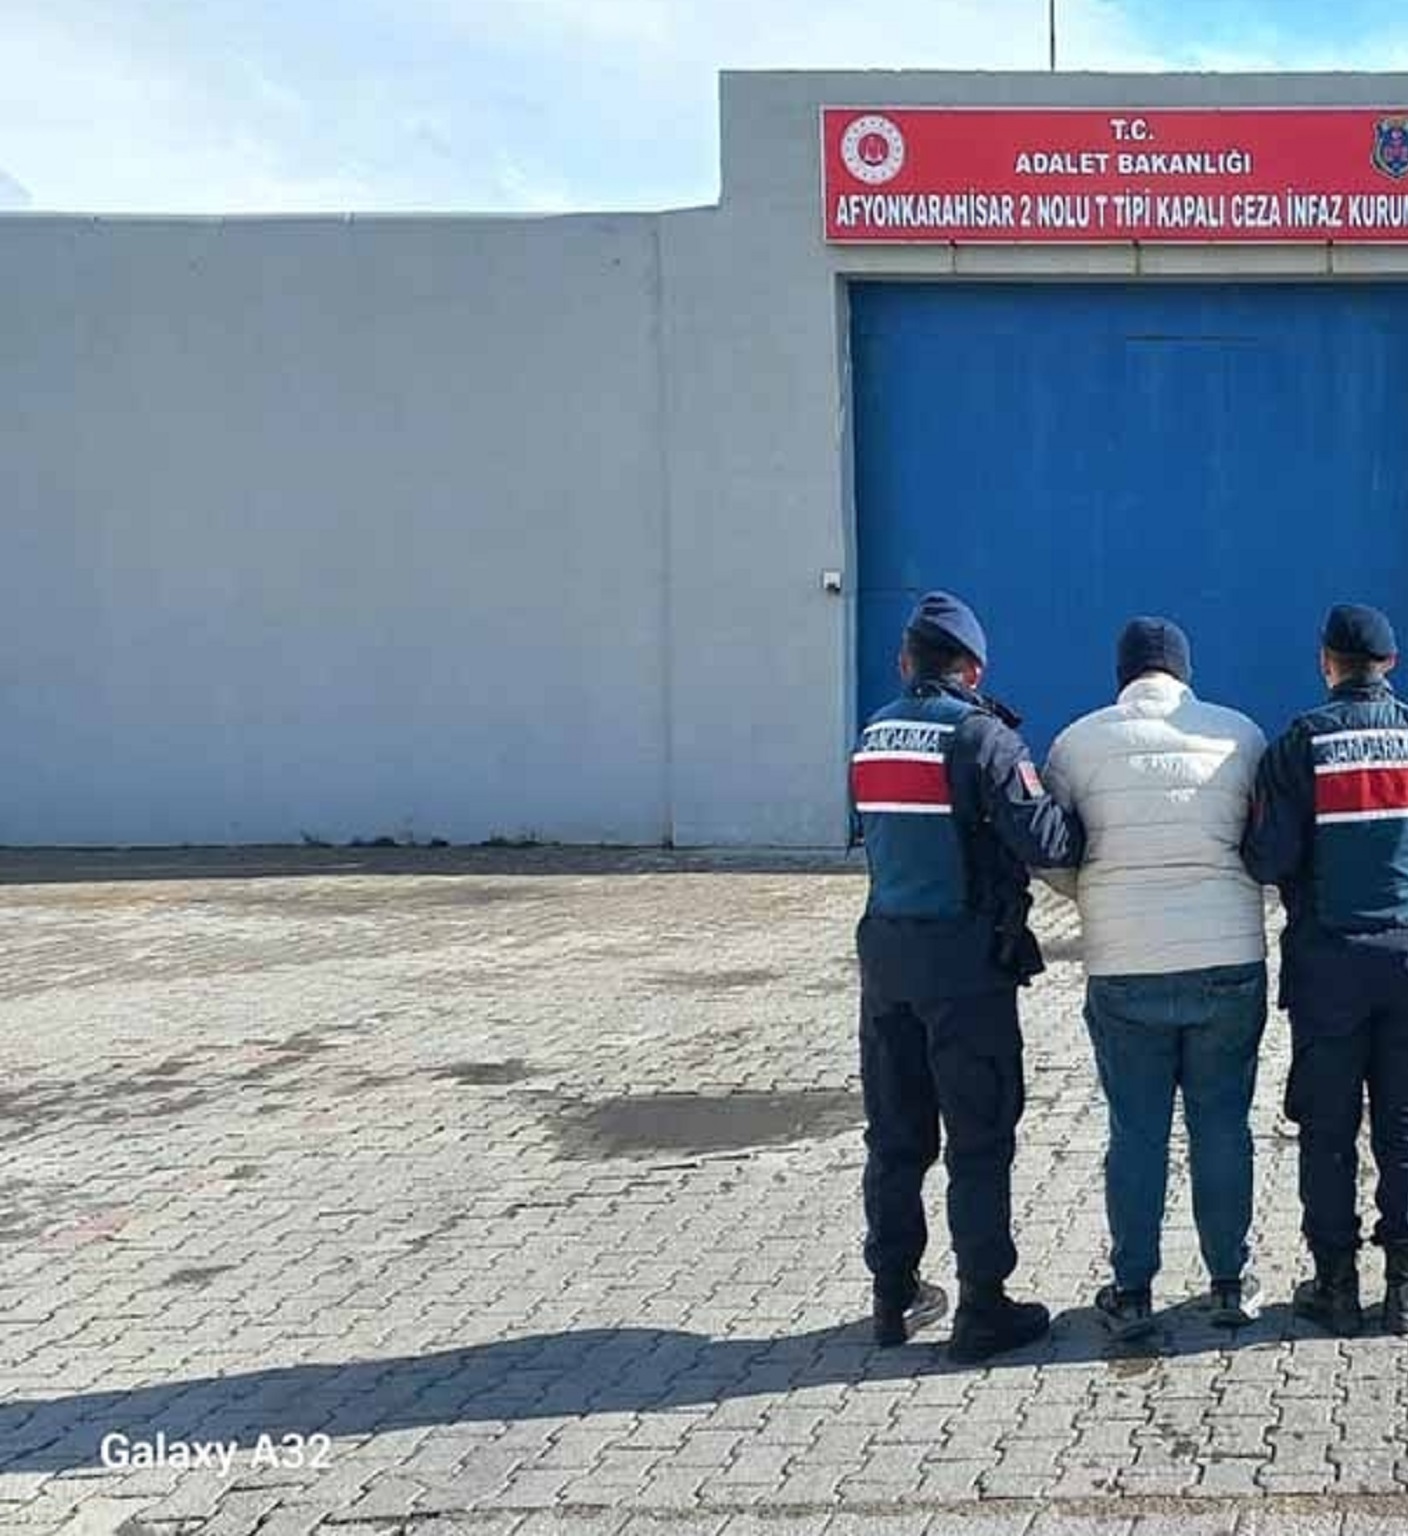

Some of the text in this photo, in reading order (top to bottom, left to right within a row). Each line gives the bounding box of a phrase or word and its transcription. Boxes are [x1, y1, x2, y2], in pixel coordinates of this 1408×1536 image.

[1110, 118, 1154, 140] T.C.
[1015, 149, 1251, 174] ADALET BAKANLIĞI
[836, 189, 1014, 228] AFYONKARAHİSAR
[1020, 195, 1031, 228] 2
[1037, 195, 1090, 228] NOLU
[1096, 195, 1108, 228] T
[1113, 188, 1151, 228] TİPİ
[1156, 195, 1225, 228] KAPALI
[1231, 195, 1281, 228] CEZA
[1286, 189, 1342, 228] İNFAZ
